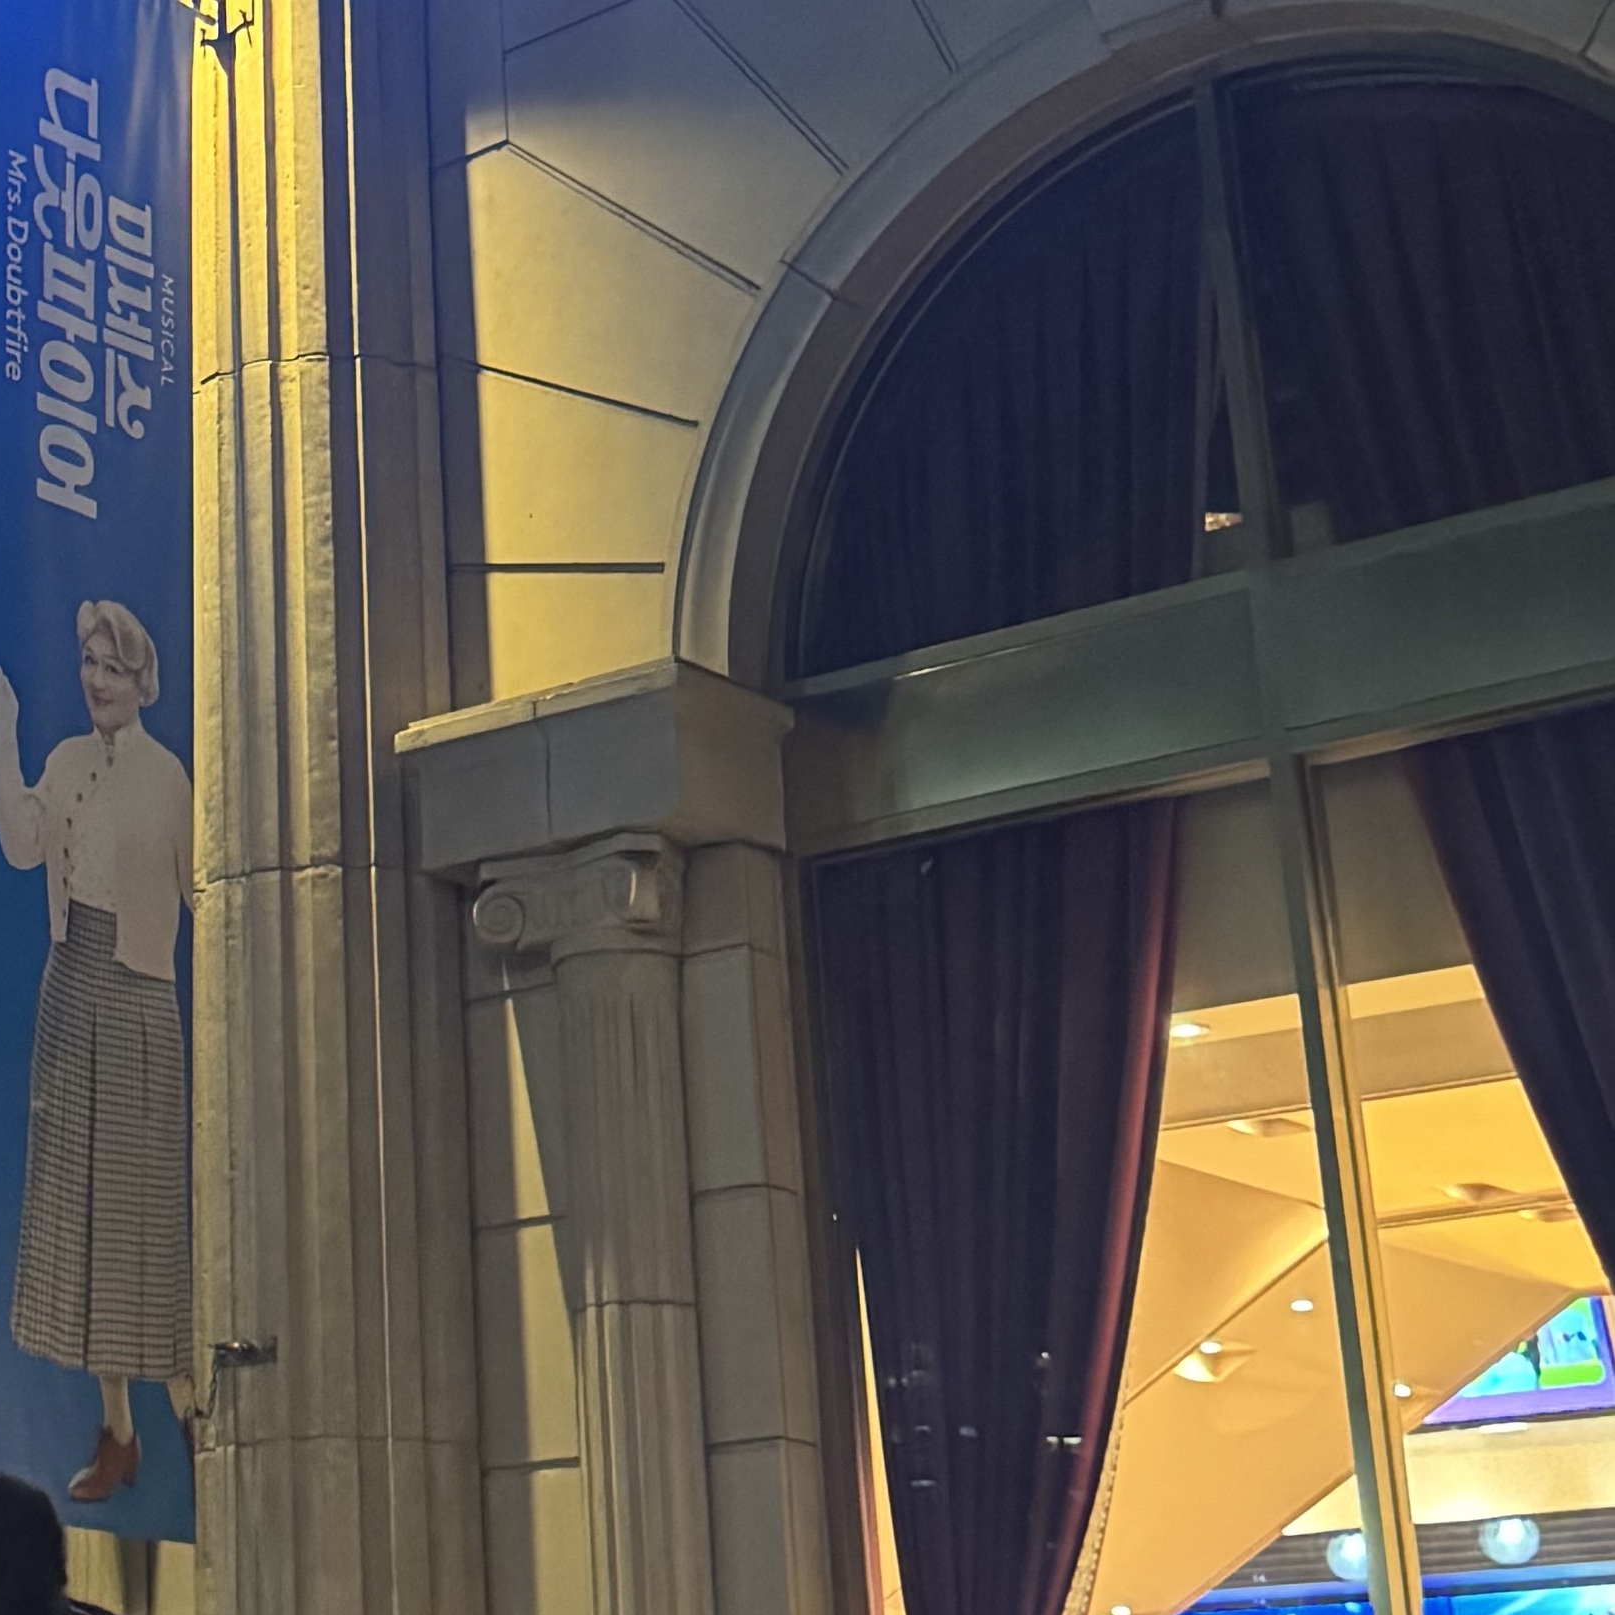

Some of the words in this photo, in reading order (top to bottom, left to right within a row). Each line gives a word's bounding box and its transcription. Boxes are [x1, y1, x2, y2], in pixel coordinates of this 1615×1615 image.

[6, 148, 28, 214] Mrs.
[5, 217, 30, 382] Doubtfire
[34, 67, 102, 519] 다웃파이어
[103, 195, 154, 440] 미세스
[160, 273, 175, 387] MUSICAL
